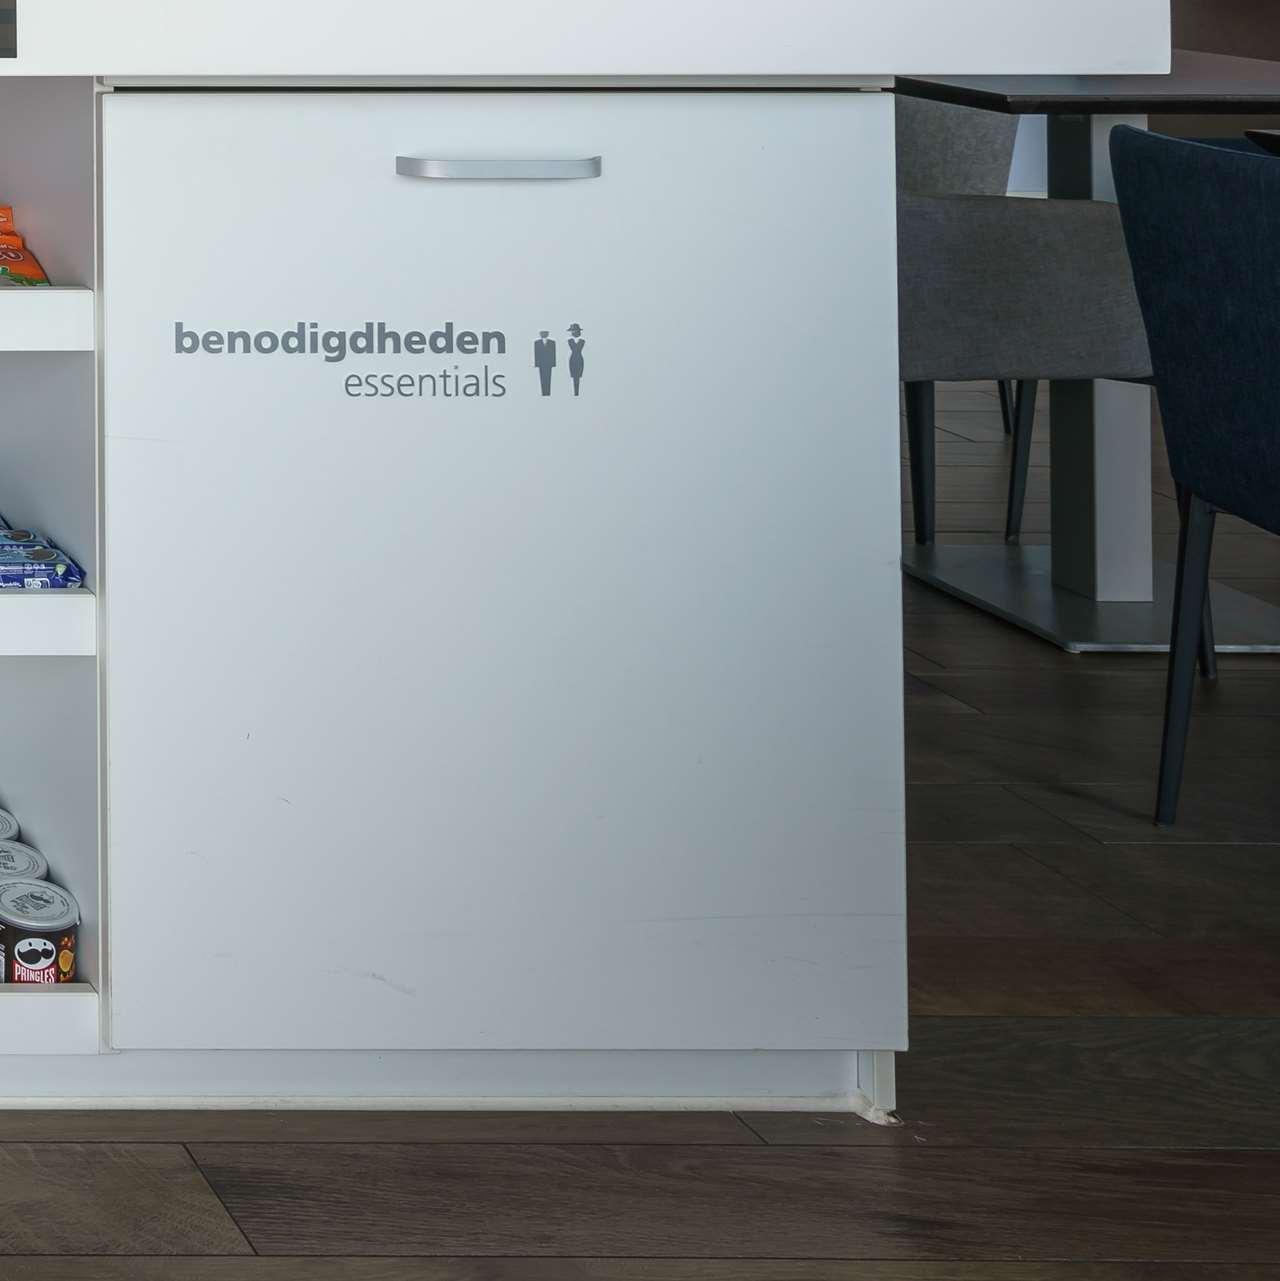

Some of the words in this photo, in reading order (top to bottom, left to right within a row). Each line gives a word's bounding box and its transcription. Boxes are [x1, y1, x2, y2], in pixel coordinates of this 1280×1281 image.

[174, 320, 507, 362] benodigdheden
[344, 365, 507, 397] essentials
[14, 967, 56, 983] PRINGLES
